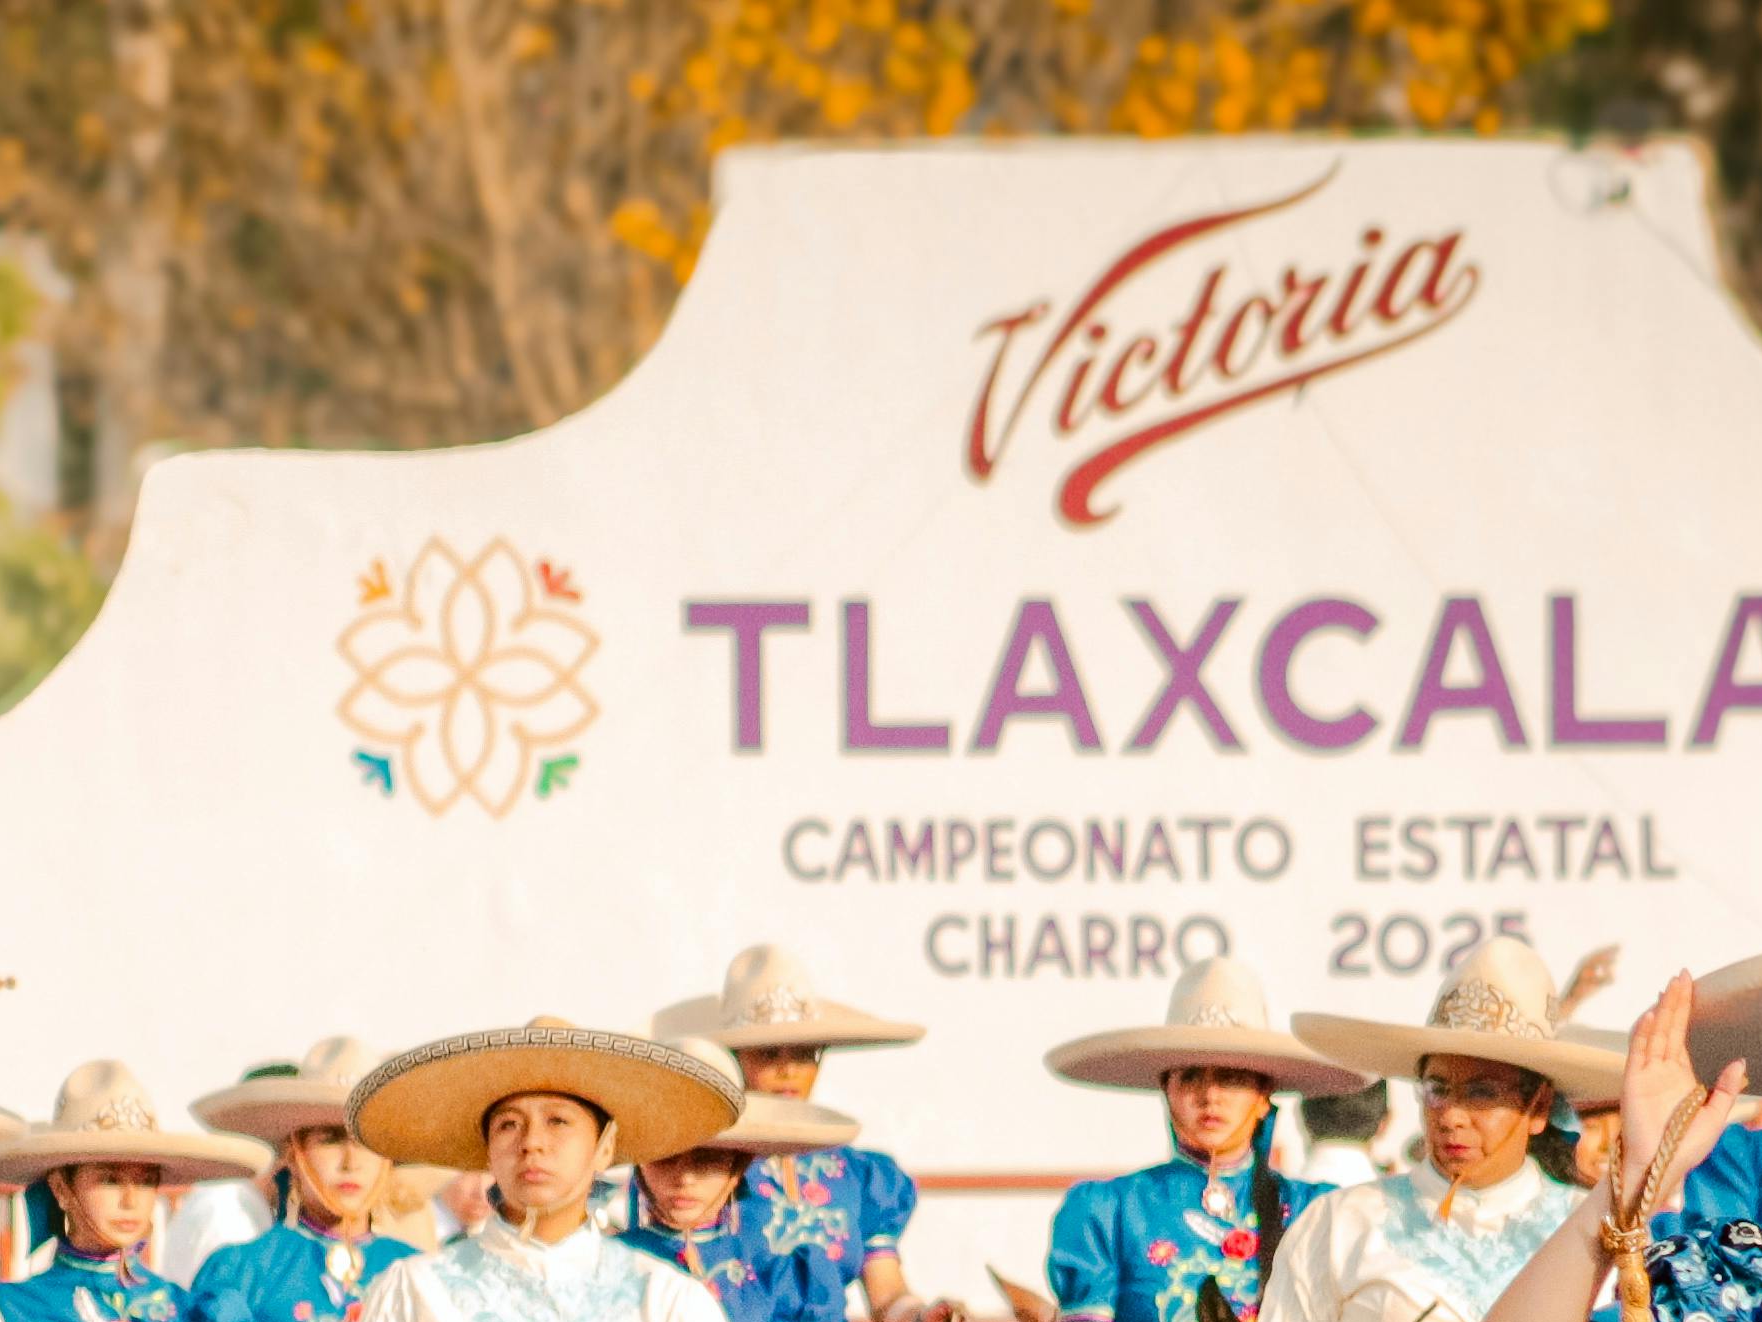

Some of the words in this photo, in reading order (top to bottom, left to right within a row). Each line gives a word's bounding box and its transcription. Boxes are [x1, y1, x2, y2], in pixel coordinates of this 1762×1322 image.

[964, 155, 1481, 530] Victoria
[783, 816, 1293, 884] CAMPEONATO
[1356, 816, 1677, 884] ESTATAL
[925, 914, 1231, 978] CHARRO
[1329, 912, 1534, 976] 2025
